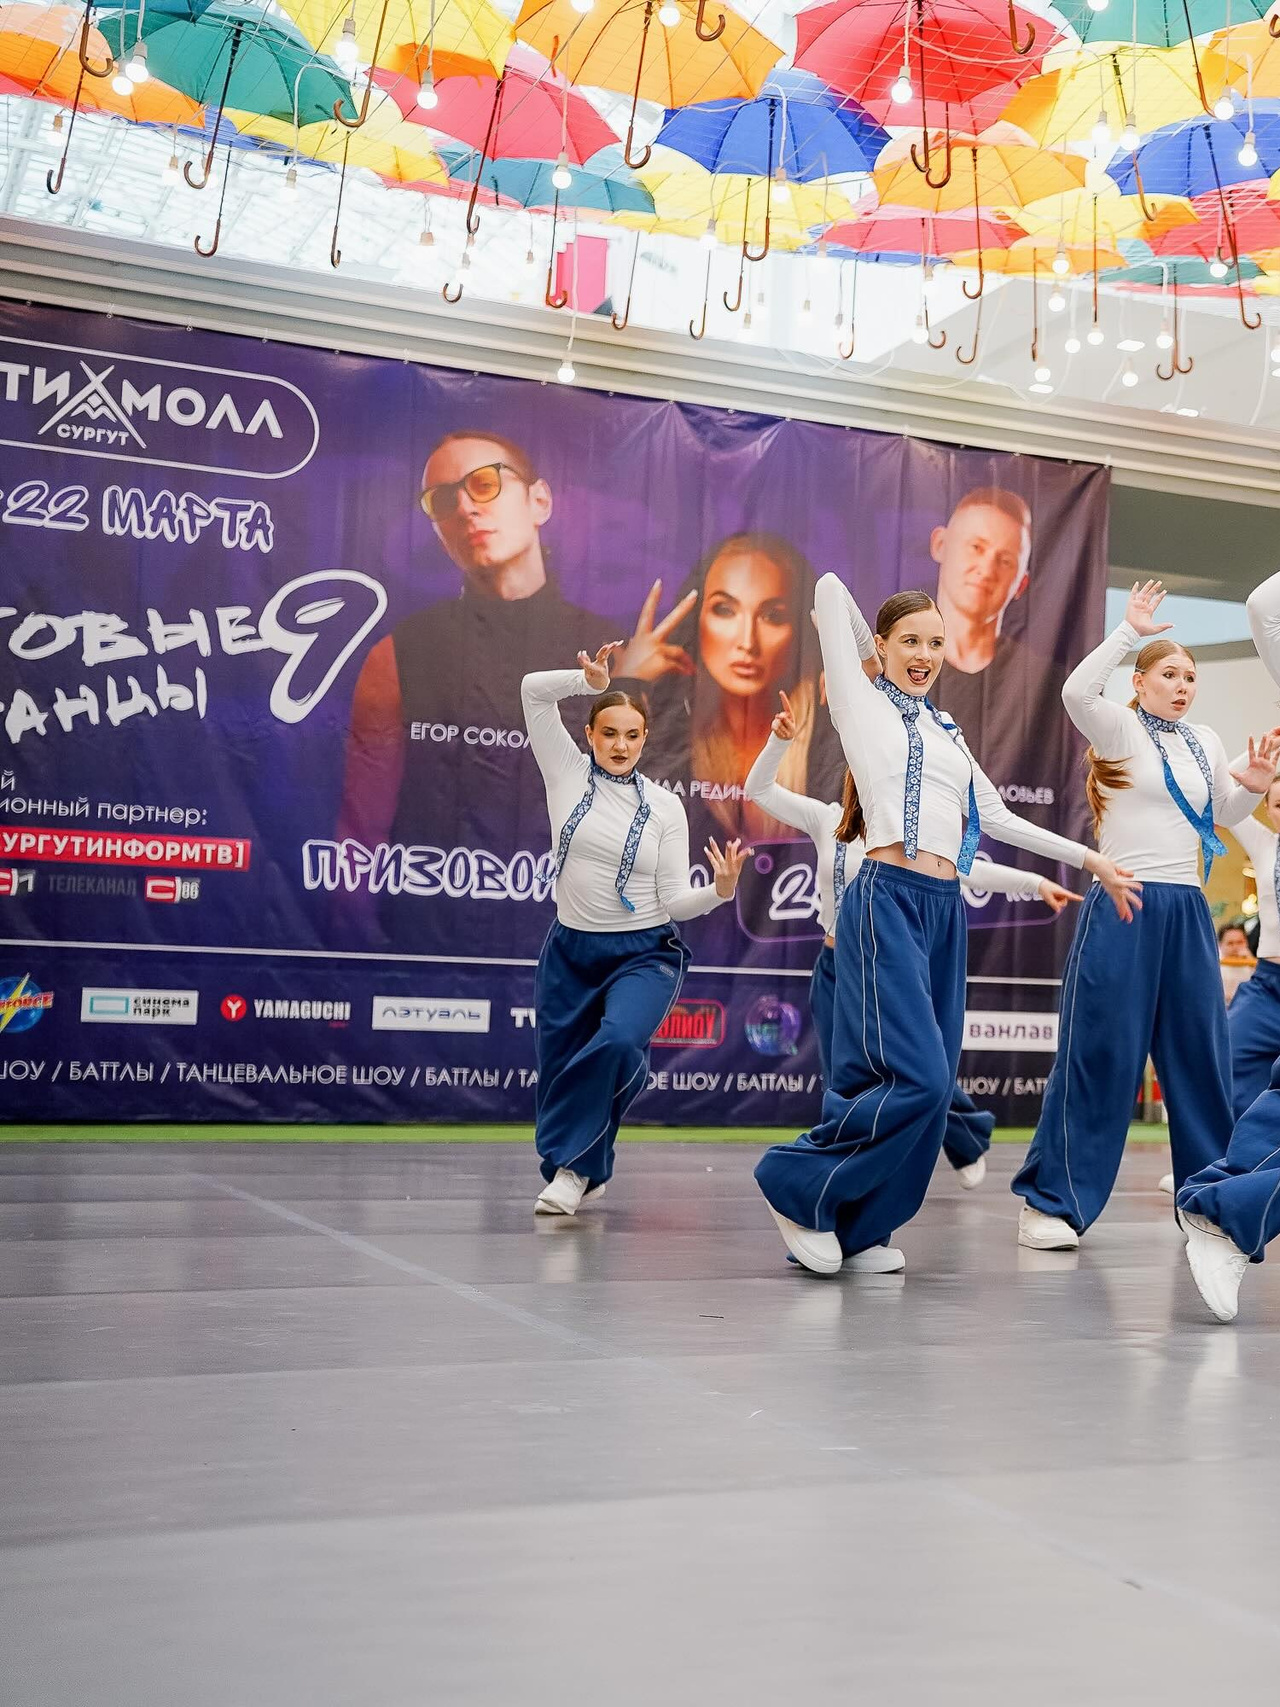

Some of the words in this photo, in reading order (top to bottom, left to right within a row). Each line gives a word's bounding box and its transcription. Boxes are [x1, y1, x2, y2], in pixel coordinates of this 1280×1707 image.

[121, 379, 284, 438] МОЛЛ
[57, 423, 129, 446] СУРГУТ
[102, 485, 274, 553] МАРТА
[0, 606, 266, 667] ОВЫЕ
[0, 664, 208, 744] АНЦЫ
[410, 721, 460, 743] ЕГОР
[690, 780, 750, 801] РЕДИН
[49, 874, 137, 896] ТЕЛЕКАНАЛ
[133, 1007, 171, 1019] парк
[254, 999, 351, 1021] YAMAGUCHI
[69, 1061, 154, 1082] БАТТЛЫ
[176, 1062, 347, 1085] ТАНЦЕВАЛЬНОЕ
[352, 1065, 406, 1086] ШОУ
[425, 1066, 500, 1088] БАТТЛЫ
[672, 1071, 722, 1091] ШОУ
[736, 1072, 804, 1093] БАТТЛЫ
